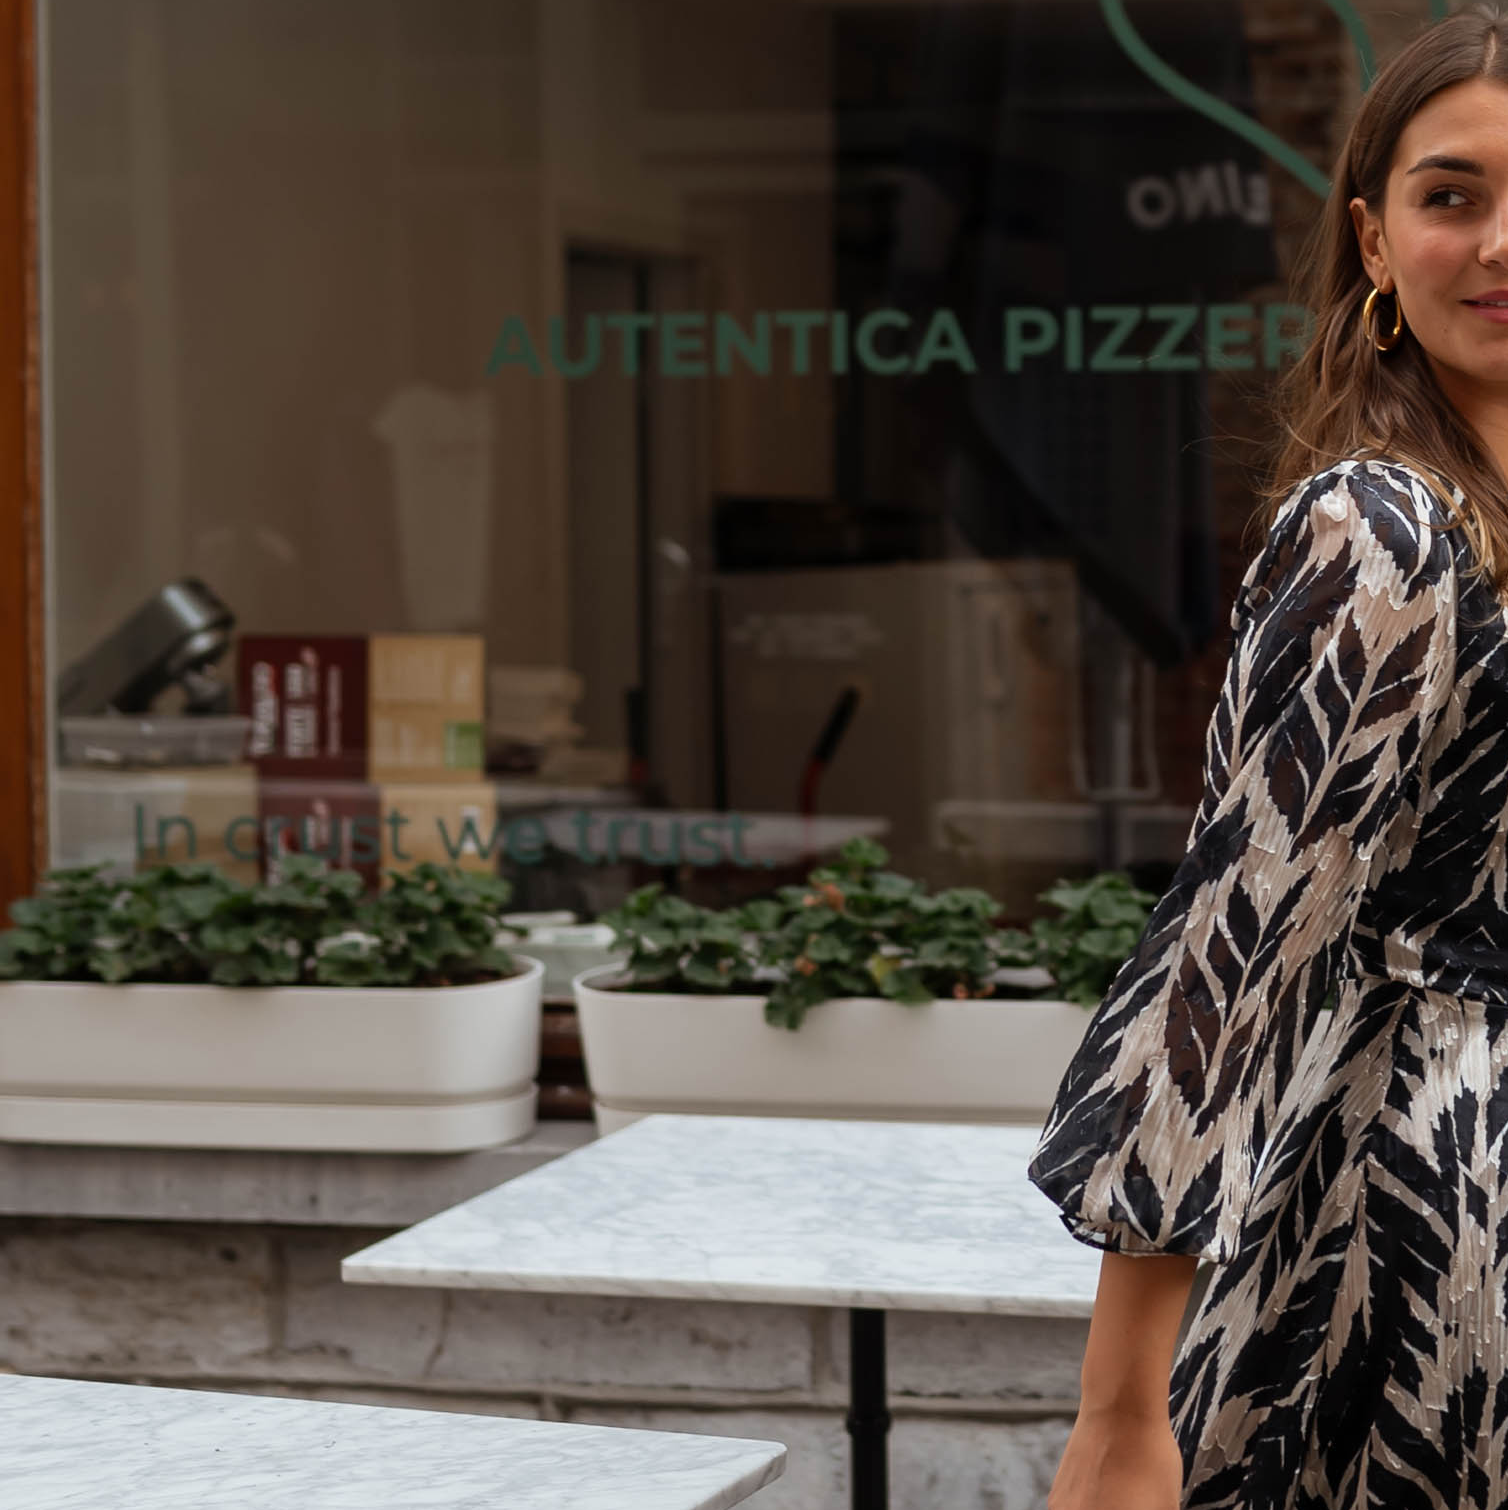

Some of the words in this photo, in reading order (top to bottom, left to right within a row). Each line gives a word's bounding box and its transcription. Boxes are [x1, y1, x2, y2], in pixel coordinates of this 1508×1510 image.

[486, 308, 977, 378] AUTENTICA
[1005, 304, 1316, 373] PIZZER
[134, 803, 196, 860] In
[225, 806, 411, 865] crust
[437, 813, 546, 867] we
[567, 811, 776, 870] trust.
